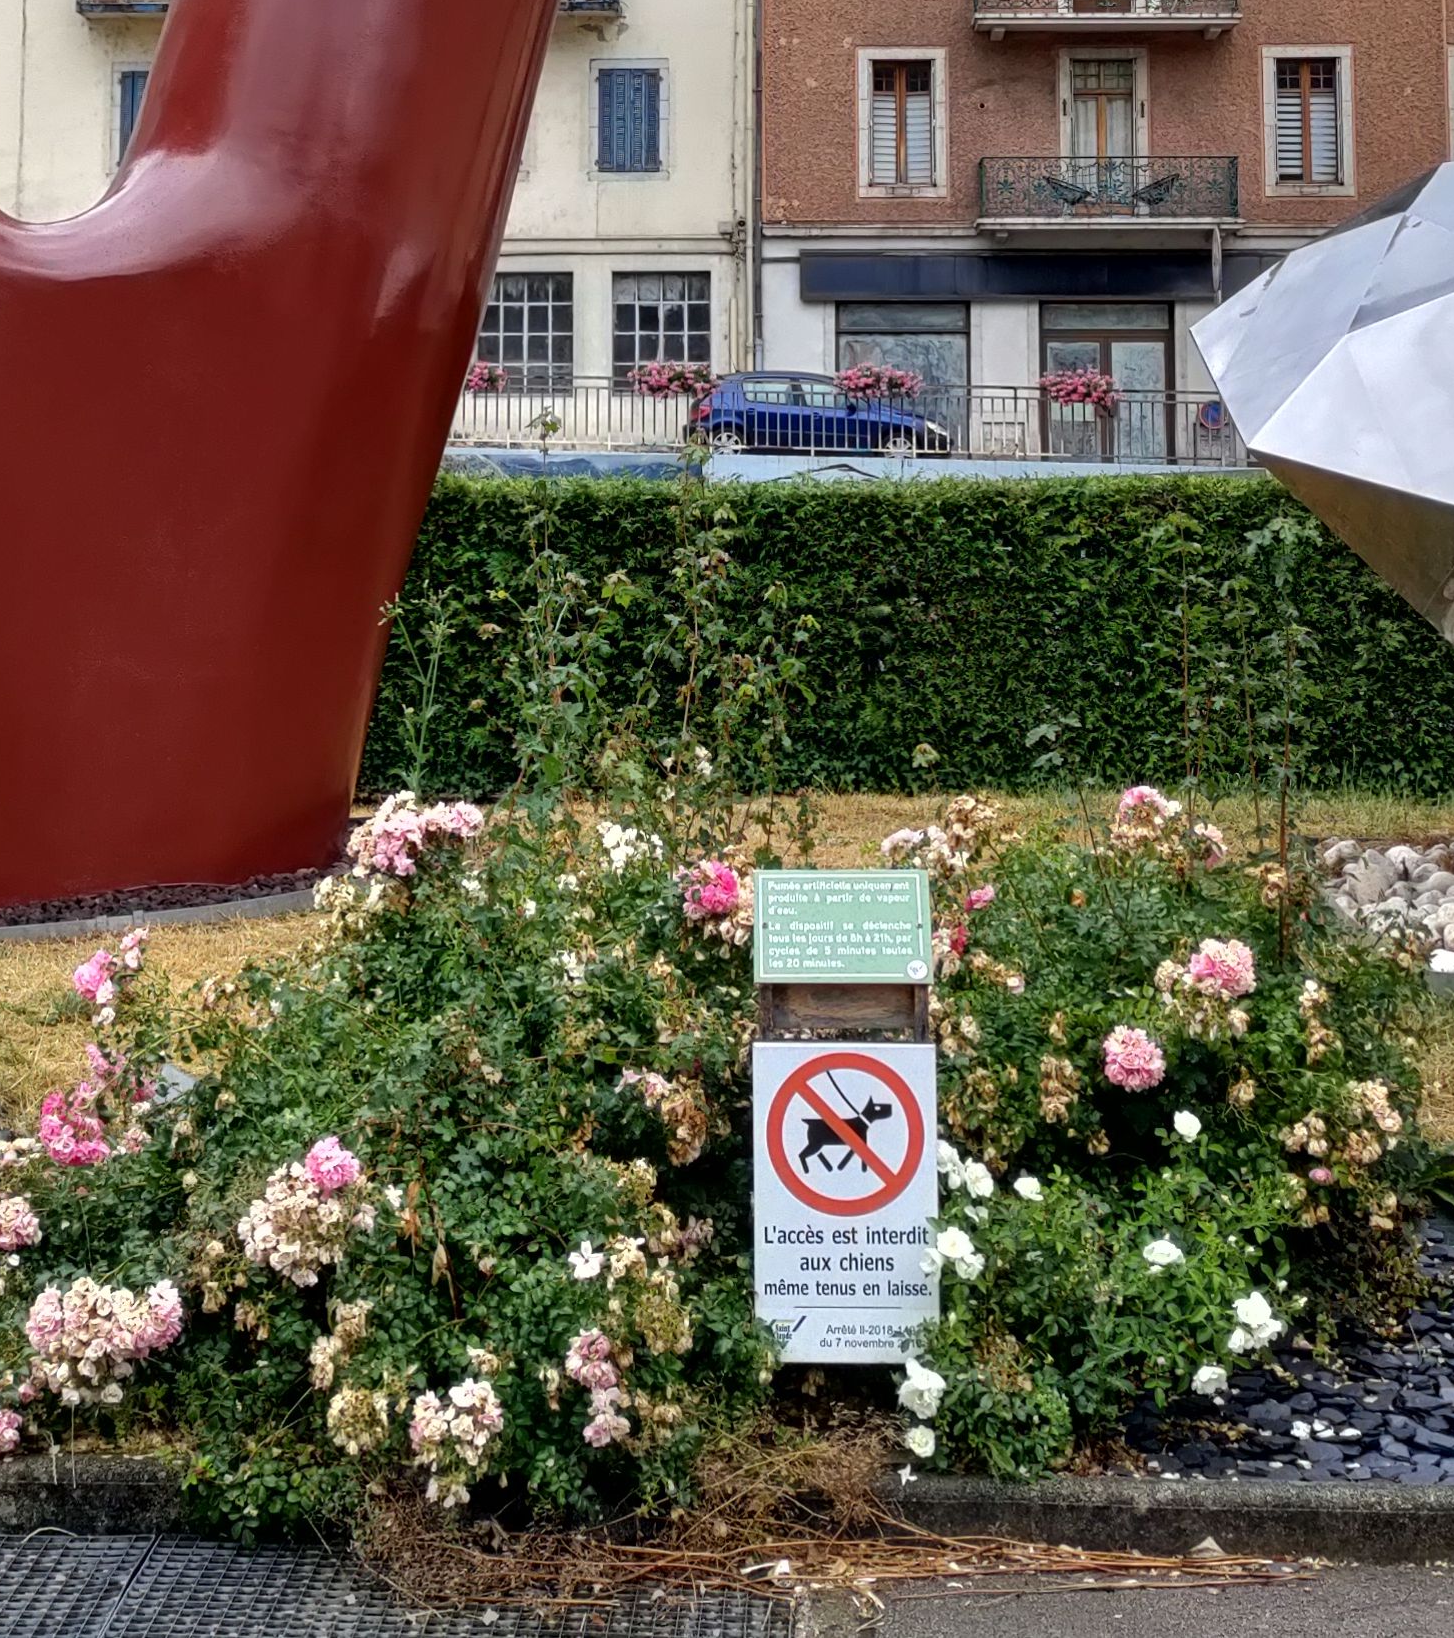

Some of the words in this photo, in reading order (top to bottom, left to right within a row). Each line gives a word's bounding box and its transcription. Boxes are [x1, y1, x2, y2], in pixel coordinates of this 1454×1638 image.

[768, 881, 801, 891] Fumée
[803, 881, 851, 891] artificielle
[768, 893, 809, 905] produite
[814, 892, 821, 903] à
[826, 893, 853, 905] partir
[859, 893, 871, 903] de
[876, 894, 911, 905] vapeur
[768, 905, 798, 915] d'eau.
[769, 921, 781, 931] Le
[790, 921, 834, 933] dispositif
[843, 922, 854, 930] se
[863, 920, 912, 930] déclenche
[769, 933, 790, 943] tous
[792, 933, 807, 943] les
[809, 933, 834, 945] jours
[836, 933, 848, 943] de
[865, 933, 872, 942] à
[896, 934, 912, 944] par
[769, 946, 801, 957] cycles
[806, 946, 818, 955] de
[824, 946, 832, 955] 5
[837, 945, 877, 955] minutes
[882, 946, 914, 955] toutes
[769, 958, 784, 968] les
[786, 958, 800, 968] 20
[803, 958, 845, 968] minutes.
[764, 1224, 824, 1245] L'accès
[832, 1227, 858, 1245] est
[866, 1226, 929, 1245] interdit
[800, 1256, 831, 1272] aux
[840, 1252, 895, 1272] chiens
[764, 1279, 809, 1296] même
[816, 1280, 856, 1296] tenus
[863, 1282, 880, 1296] en
[888, 1279, 932, 1297] laisse.
[826, 1324, 857, 1336] Arrêté
[820, 1338, 832, 1348] du
[836, 1338, 842, 1348] 7
[844, 1338, 895, 1348] novembre
